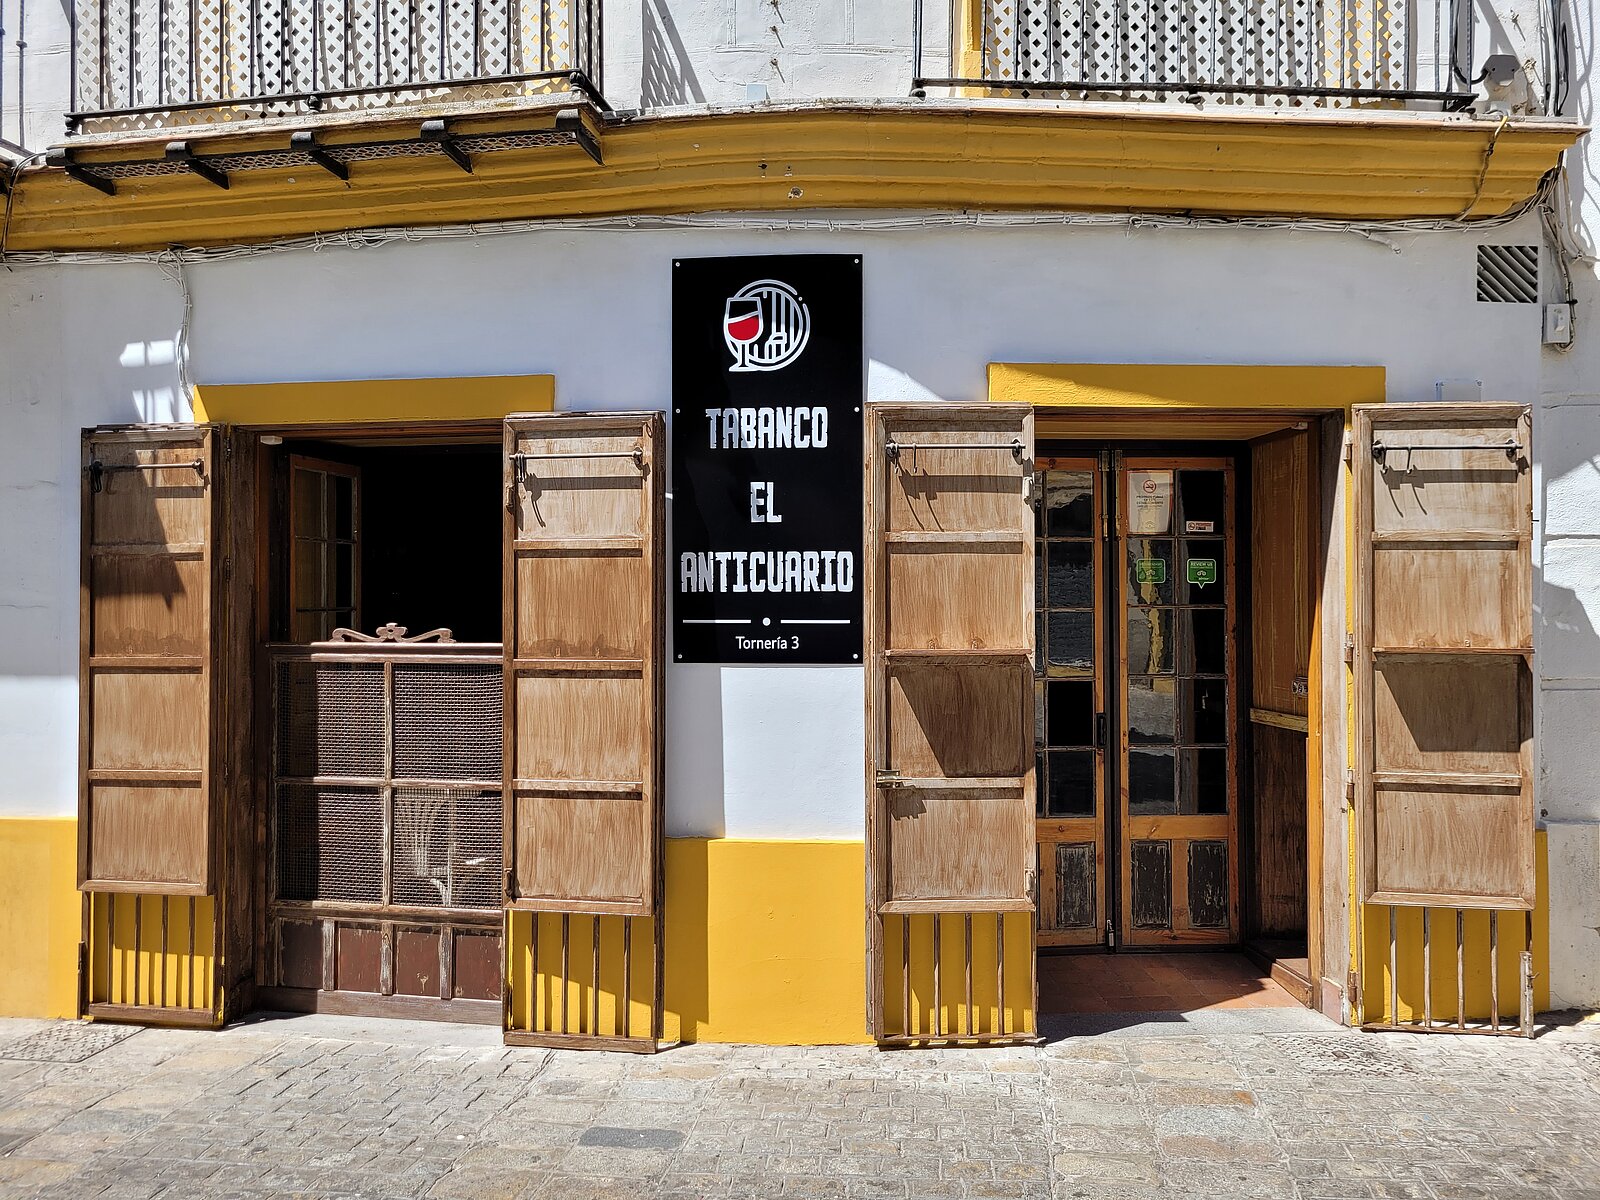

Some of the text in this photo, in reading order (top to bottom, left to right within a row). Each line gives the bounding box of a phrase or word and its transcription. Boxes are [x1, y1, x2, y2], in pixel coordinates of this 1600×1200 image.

[705, 406, 828, 449] TABANCO
[750, 481, 782, 523] EL
[680, 551, 853, 593] ANTICUARIO
[735, 636, 800, 650] Tornería 3
